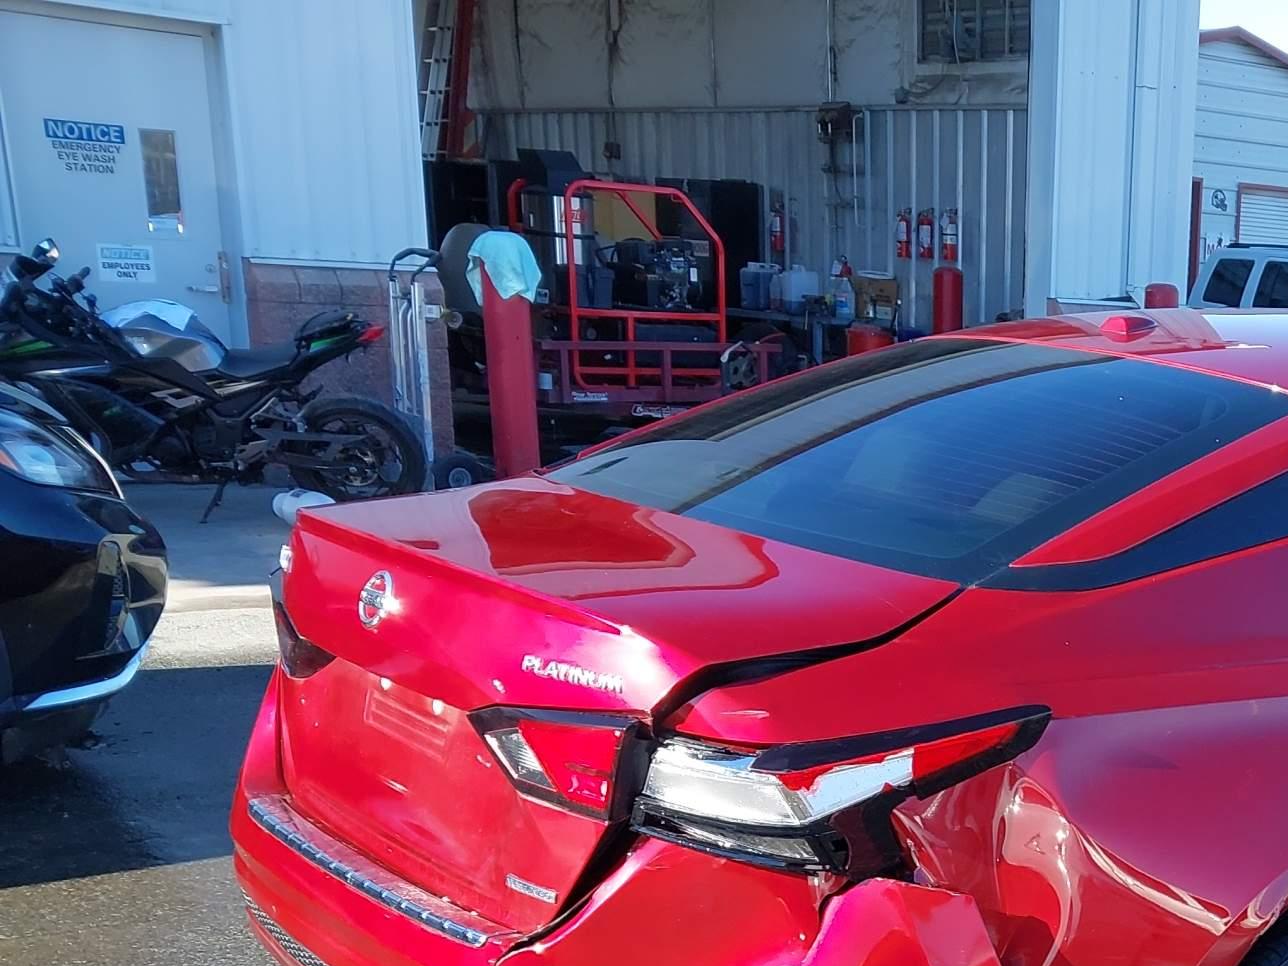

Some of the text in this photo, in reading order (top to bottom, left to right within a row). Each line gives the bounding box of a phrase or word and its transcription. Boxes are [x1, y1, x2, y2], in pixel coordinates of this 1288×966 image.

[47, 119, 122, 142] NOTICE
[52, 140, 121, 154] EMERGENCY
[58, 152, 116, 164] EYE WASH
[65, 162, 115, 174] STATION
[102, 249, 148, 260] NOTICE
[102, 262, 151, 271] EMPLOYEES
[116, 271, 138, 279] ONLY
[521, 654, 624, 694] PLATINUM
